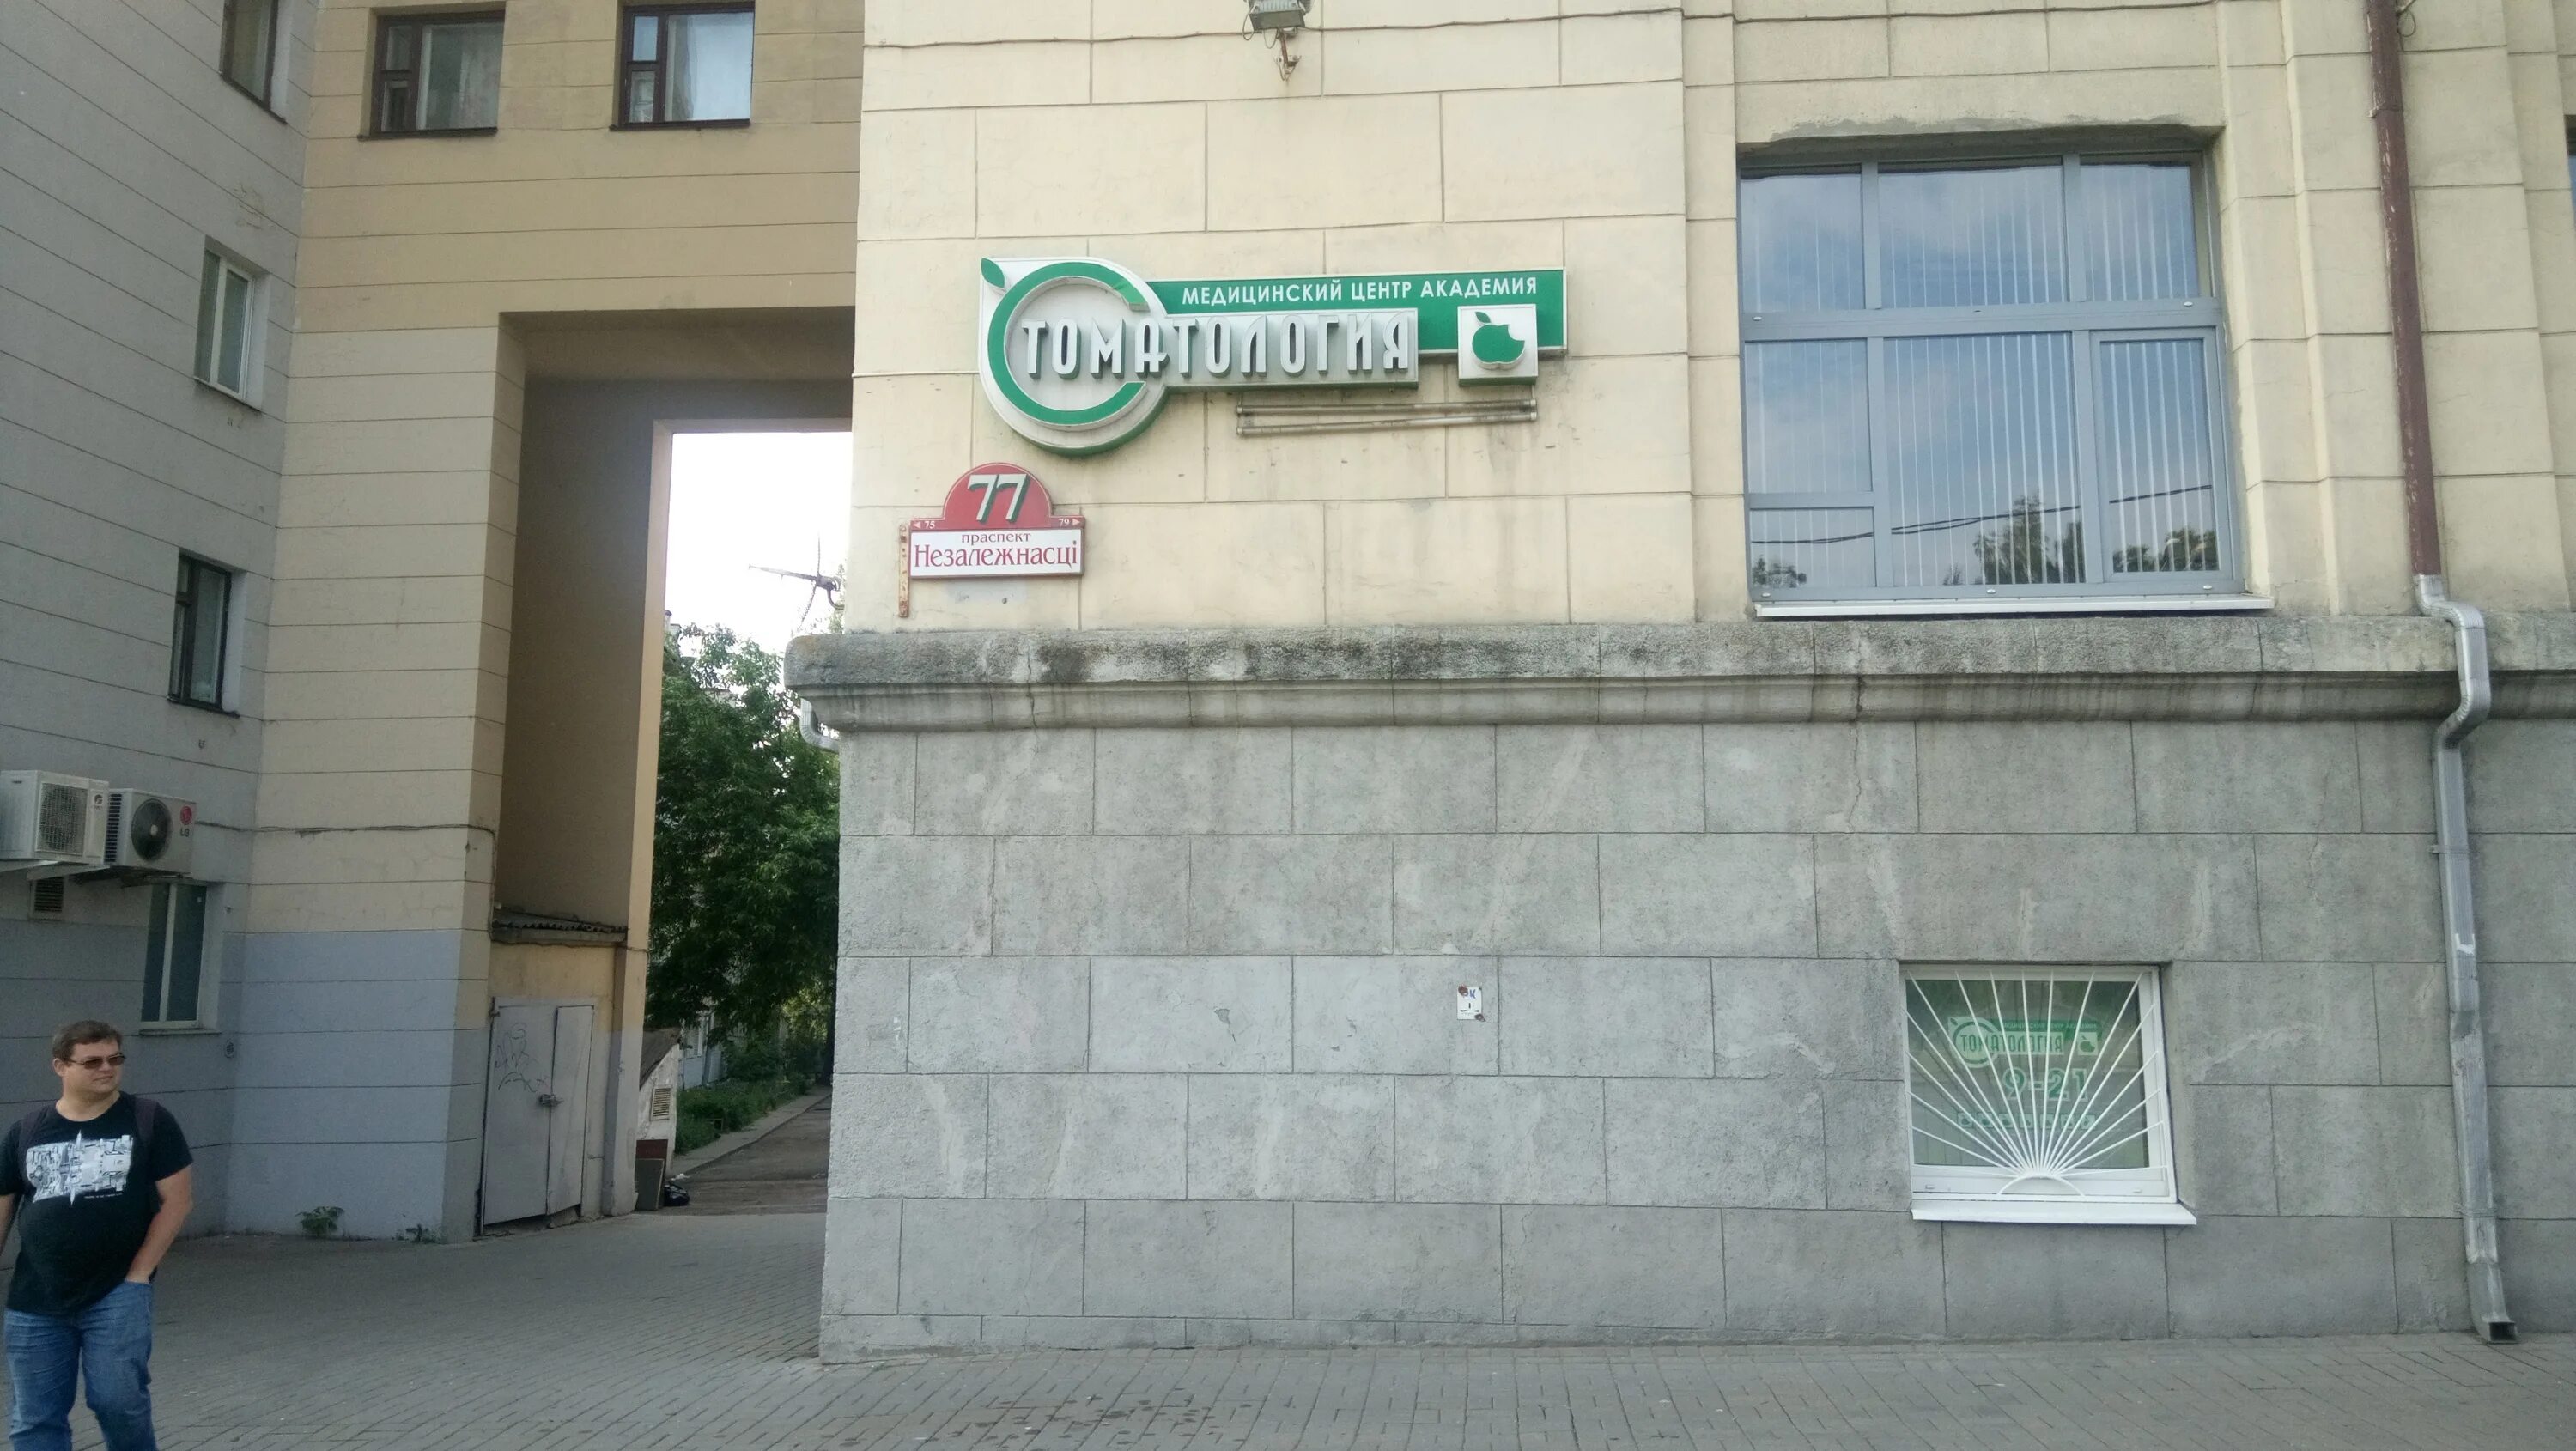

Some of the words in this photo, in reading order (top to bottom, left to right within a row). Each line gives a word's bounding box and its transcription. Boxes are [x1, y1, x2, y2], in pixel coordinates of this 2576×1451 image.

[1182, 279, 1342, 306] МЕДИЦИНСКИЙ
[1351, 281, 1413, 302] ЦЕНТР
[1419, 276, 1537, 299] АКАДЕМИЯ
[968, 473, 1030, 524] 77
[924, 520, 936, 529] 75
[1058, 518, 1070, 526] 79
[961, 531, 1031, 545] праспект
[914, 540, 1078, 569] Незалежнасці
[179, 828, 191, 837] LG
